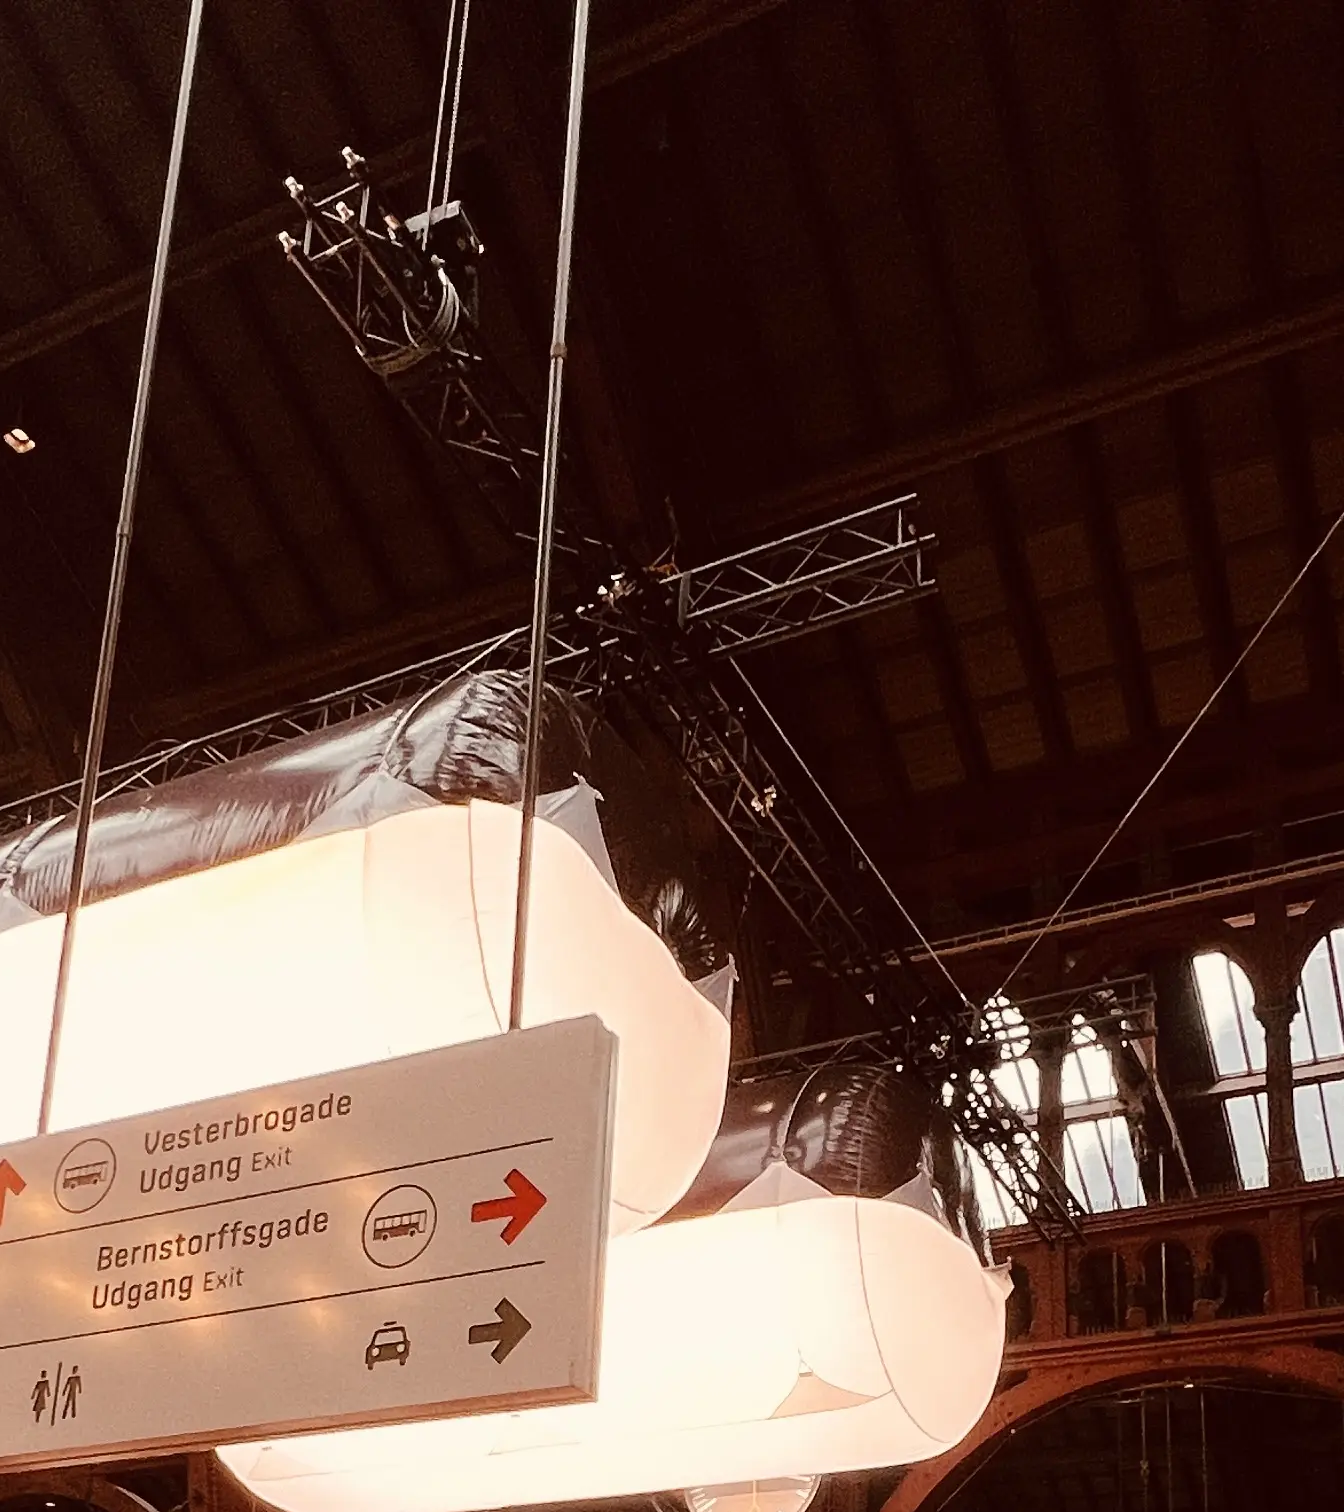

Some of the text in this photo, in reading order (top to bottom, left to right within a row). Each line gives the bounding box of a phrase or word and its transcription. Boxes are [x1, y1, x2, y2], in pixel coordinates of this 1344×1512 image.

[144, 1092, 352, 1155] Vesterbrogade
[139, 1146, 293, 1194] Udgang Exit
[96, 1208, 329, 1272] Bernstorffsgade
[92, 1267, 245, 1310] Udgang Exit
